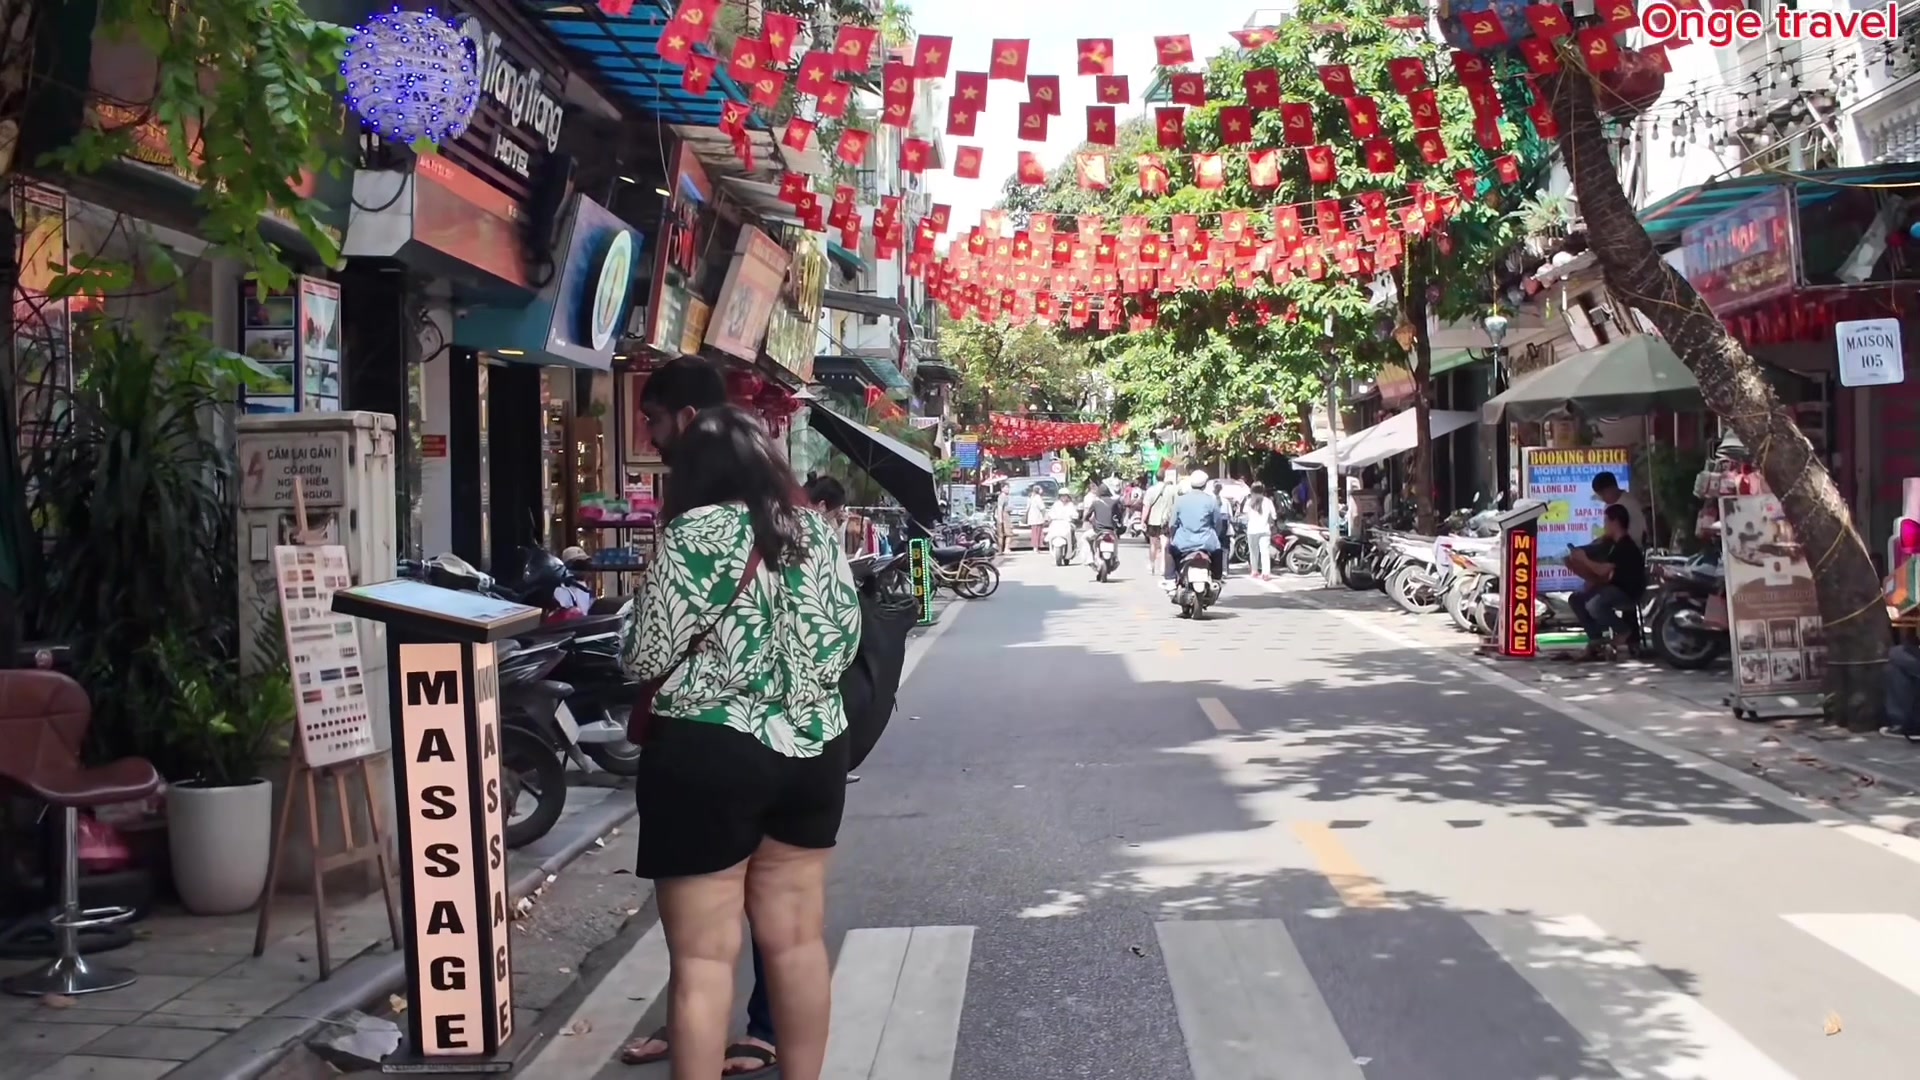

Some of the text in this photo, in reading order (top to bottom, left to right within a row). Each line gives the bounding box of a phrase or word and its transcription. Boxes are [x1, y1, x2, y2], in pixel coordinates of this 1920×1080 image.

[494, 133, 530, 178] HOTEL
[1846, 333, 1894, 353] MAISON
[1861, 353, 1884, 369] 105
[1530, 449, 1628, 465] BOOKING OFFICE
[1533, 466, 1568, 476] MONEY
[1531, 484, 1577, 494] HA LONG BAY
[1574, 508, 1593, 517] SAPA
[1567, 522, 1588, 531] TOURS
[1513, 535, 1530, 650] MASSAGE
[406, 670, 469, 1049] MASSAGE
[477, 666, 509, 1046] MASSAGE
